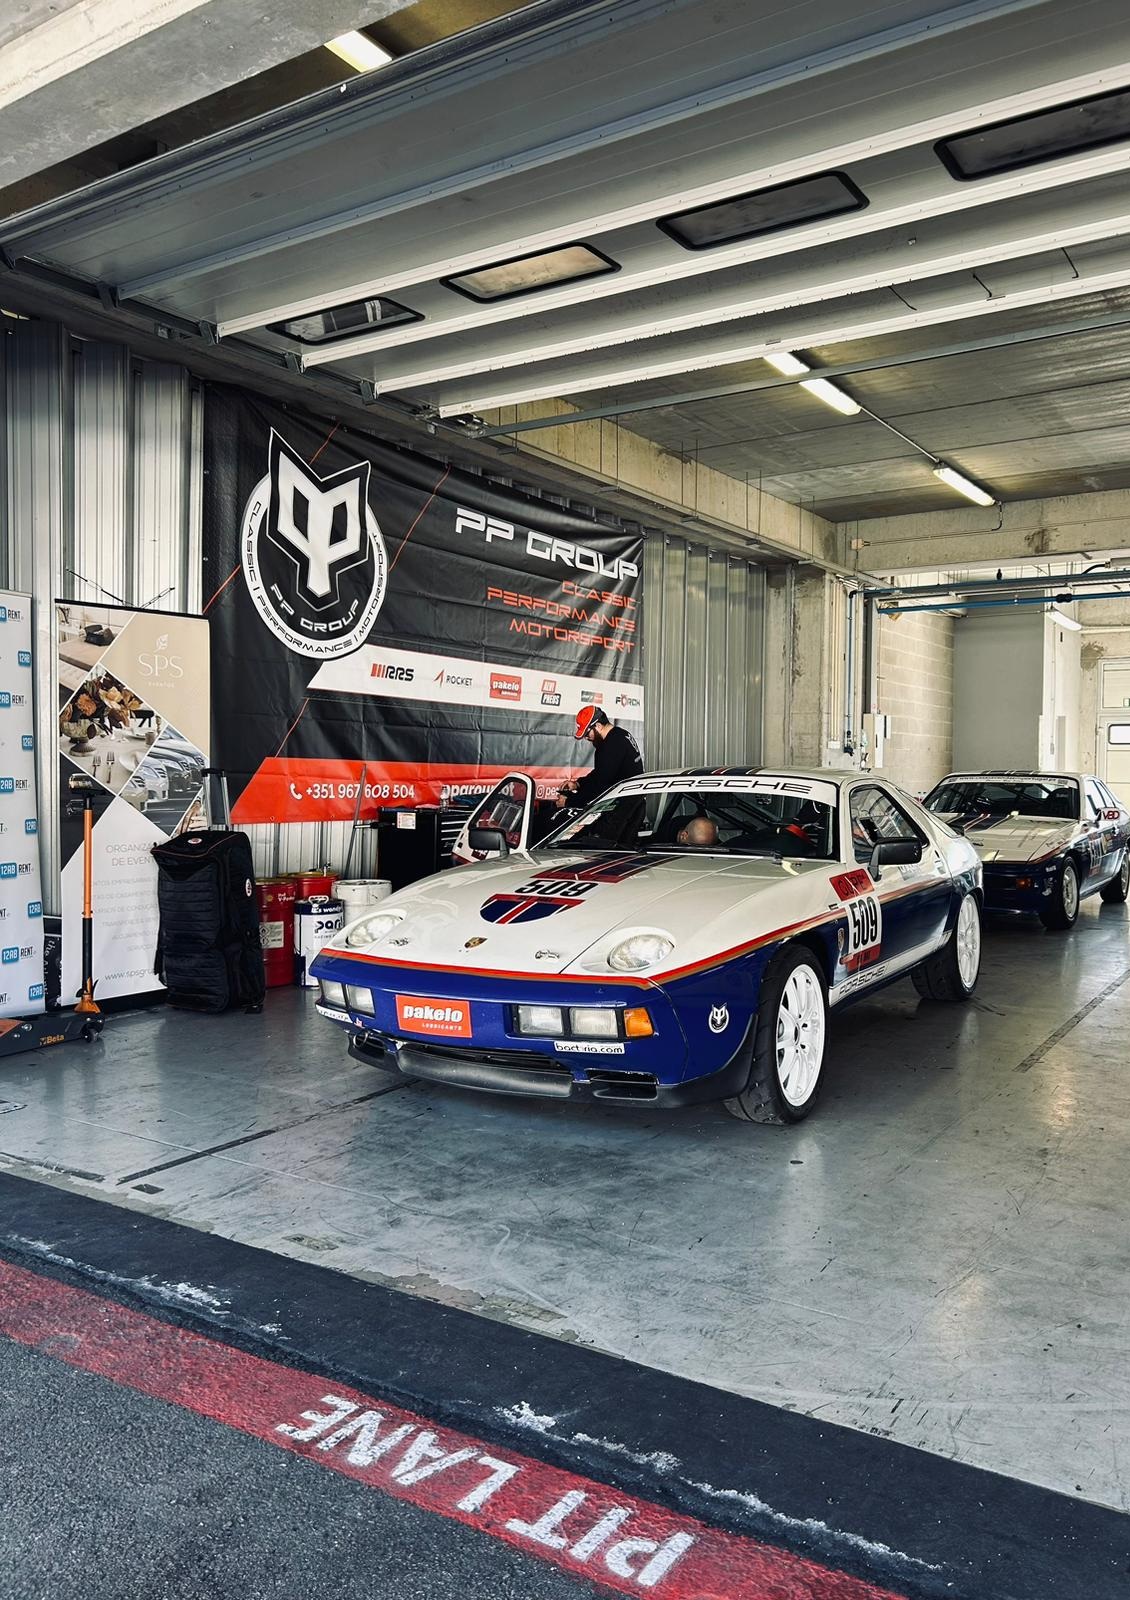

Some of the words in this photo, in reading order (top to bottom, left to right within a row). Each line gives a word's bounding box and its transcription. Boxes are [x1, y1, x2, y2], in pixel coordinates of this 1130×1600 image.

[246, 500, 262, 583] CLASSIC
[455, 507, 515, 543] PP
[526, 531, 638, 580] GROUP
[270, 583, 295, 616] PP
[300, 598, 359, 633] GROUP
[561, 580, 636, 610] CLASSIC
[487, 587, 636, 632] PERFORMANCE
[256, 594, 353, 654] PERFORMANCE
[509, 618, 635, 653] MOTORSPORT
[137, 653, 184, 679] SPS
[446, 675, 473, 686] ROCKET
[492, 680, 519, 691] pakelo
[16, 779, 28, 789] RENT
[306, 783, 335, 799] +351
[338, 783, 361, 799] 967
[365, 784, 390, 799] 608
[392, 784, 415, 799] 504
[618, 779, 813, 795] PORSCHE
[1, 864, 16, 875] 12AB
[19, 863, 31, 873] RENT
[514, 879, 599, 897] 509
[849, 896, 878, 949] 509
[3, 949, 18, 960] 12AB
[20, 946, 33, 957] RENT
[839, 966, 886, 995] PORSCHE
[402, 1004, 463, 1023] pakelo
[46, 1033, 65, 1044] Beta
[276, 1393, 525, 1513] LANE
[505, 1488, 697, 1587] PIT
